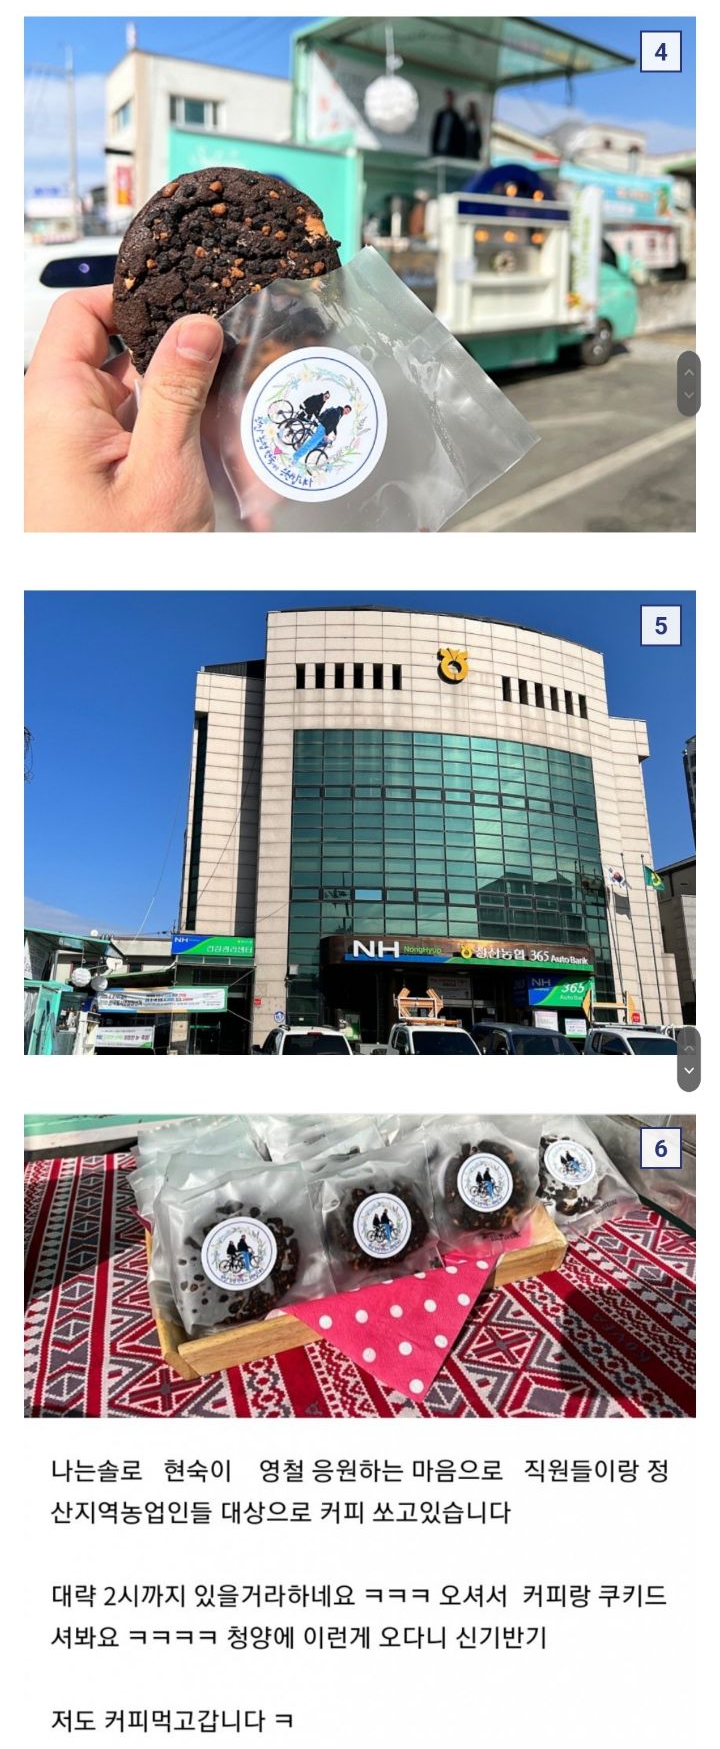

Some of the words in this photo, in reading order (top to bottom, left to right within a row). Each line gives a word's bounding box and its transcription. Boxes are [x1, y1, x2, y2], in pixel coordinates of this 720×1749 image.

[353, 939, 400, 959] NH
[404, 945, 442, 955] NongHyup
[530, 950, 549, 962] 365
[551, 955, 570, 965] Auto
[571, 956, 589, 966] Bank
[531, 977, 551, 987] NH
[561, 982, 586, 993] 365
